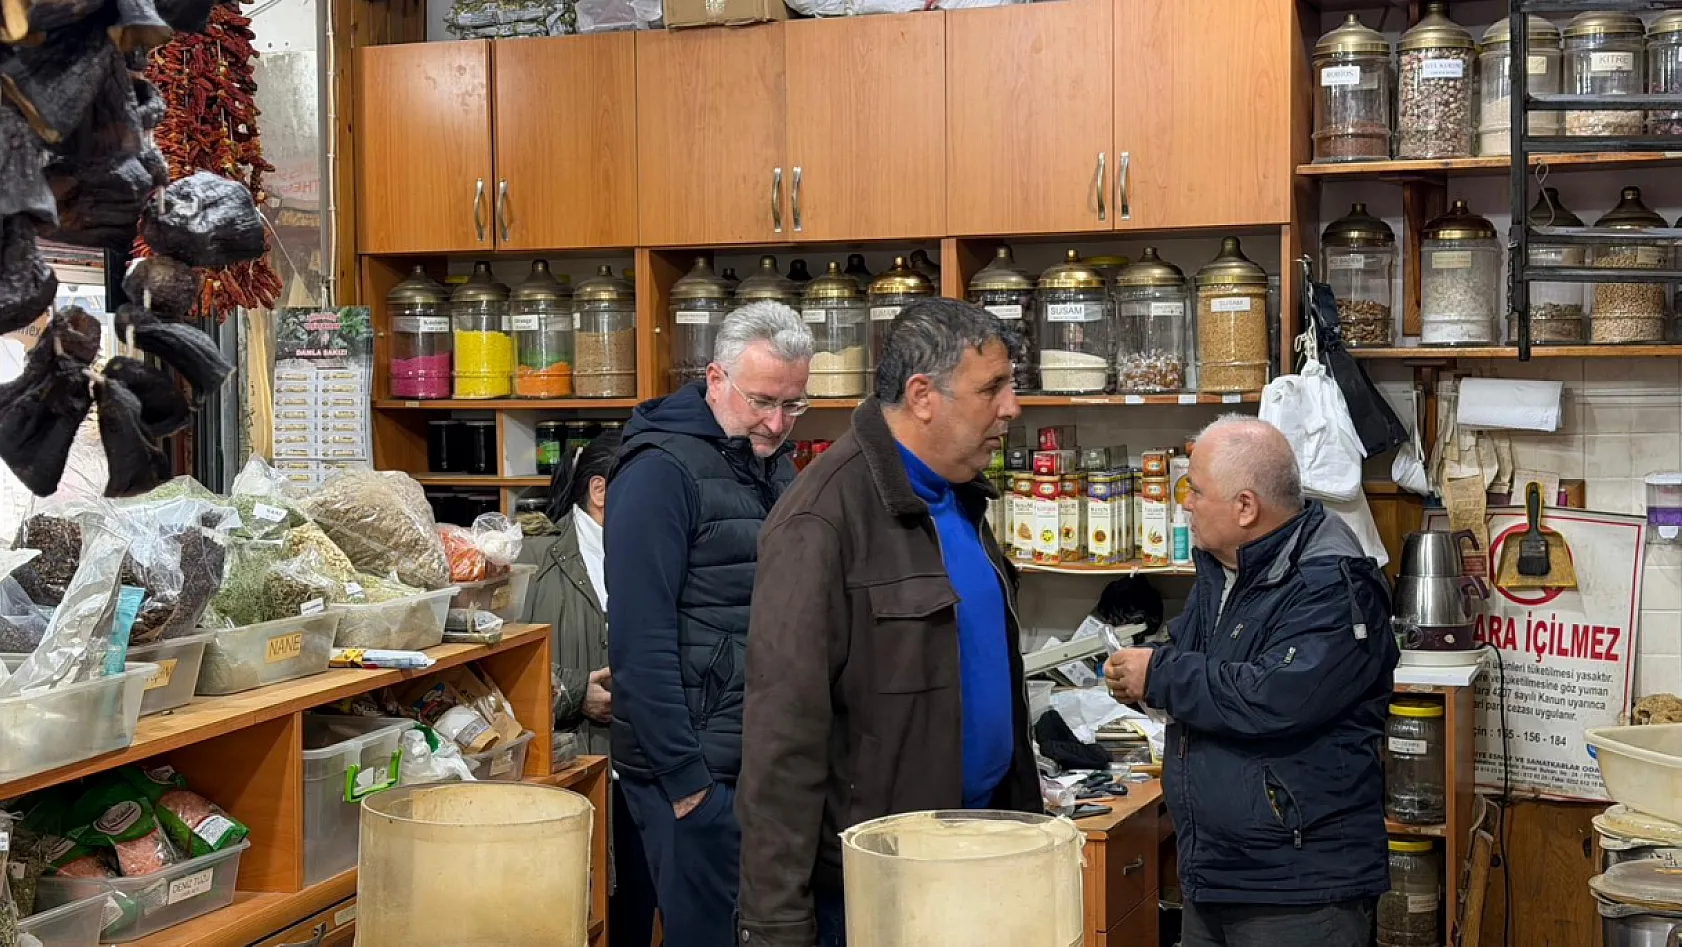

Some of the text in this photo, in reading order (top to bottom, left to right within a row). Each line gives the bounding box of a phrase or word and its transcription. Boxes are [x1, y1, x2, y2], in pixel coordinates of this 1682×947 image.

[1050, 306, 1083, 316] SUSAM
[268, 633, 300, 653] NANE
[1472, 610, 1621, 663] ARA İÇİLMEZ
[1527, 663, 1574, 680] tüketilmesi
[1503, 674, 1558, 690] üketilmesine
[1560, 682, 1577, 694] göz
[1578, 685, 1608, 697] yuman
[1538, 691, 1566, 706] Kanun
[1568, 697, 1606, 710] uyarınca
[1507, 704, 1534, 715] cezası
[1523, 731, 1541, 743] 156
[1550, 735, 1567, 746] 184
[1582, 765, 1600, 774] ODA
